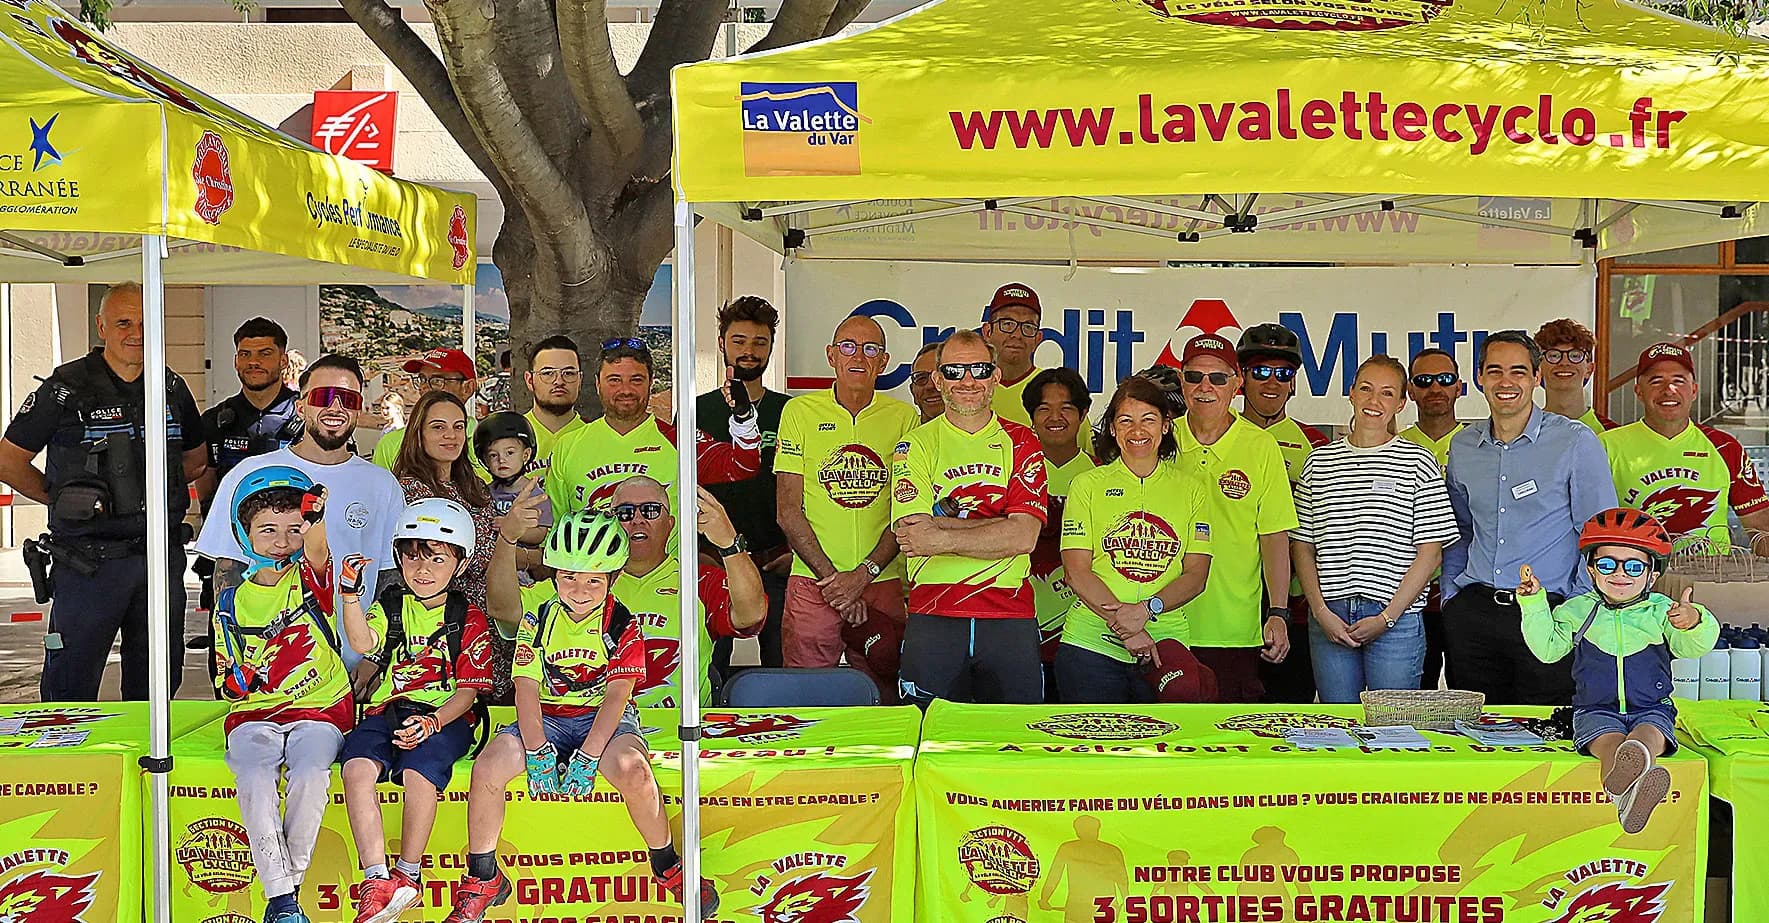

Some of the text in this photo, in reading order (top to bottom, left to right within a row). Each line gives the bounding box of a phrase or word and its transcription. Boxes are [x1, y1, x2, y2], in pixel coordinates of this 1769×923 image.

[743, 109, 856, 130] La Valette
[949, 87, 1688, 155] www.lavalettecyclo.fr
[807, 132, 855, 145] du Var
[306, 191, 343, 228] Cycles
[90, 407, 122, 417] POLICE
[586, 462, 649, 481] VALETTE
[837, 470, 888, 481] VALETTE
[943, 463, 1003, 481] VALETTE
[1640, 467, 1701, 486] VALETTE
[840, 480, 872, 489] CYCLO
[1624, 488, 1640, 504] LA
[1103, 537, 1180, 554] LA VALETTE
[1125, 549, 1160, 560] CYCLO
[546, 648, 598, 663] VALETTE
[15, 783, 86, 796] CAPABLE
[90, 782, 99, 795] ?
[699, 796, 729, 807] PAS
[732, 796, 752, 807] EN
[755, 795, 795, 807] ETRE
[797, 794, 868, 806] CAPABLE
[870, 792, 880, 804] ?
[945, 791, 988, 806] VOUS
[992, 799, 1066, 812] AIMERIEZ
[1069, 798, 1114, 812] FAIRE
[1117, 798, 1139, 811] DU
[1141, 794, 1182, 811] VÉLO
[1187, 796, 1228, 810] DANS
[1233, 795, 1255, 808] UN
[1258, 794, 1298, 808] CLUB
[1302, 793, 1311, 806] ?
[1315, 792, 1358, 806] VOUS
[1361, 791, 1440, 805] CRAIGNEZ
[1443, 791, 1464, 804] DE
[1467, 791, 1490, 804] NE
[1492, 791, 1523, 805] PAS
[1527, 791, 1548, 805] EN
[1552, 791, 1592, 805] ETRE
[188, 819, 246, 834] SECTION VTT
[1006, 829, 1025, 843] VTT
[178, 848, 253, 863] LA VALETT
[500, 853, 564, 867] VOUS
[568, 850, 651, 867] PROPO
[960, 846, 979, 862] LA
[203, 859, 240, 872] CYCLO
[1134, 864, 1461, 882] NOTRE CLUB VOUS PROPOSE
[751, 852, 847, 897] LA VALETTE
[317, 884, 340, 910] 3
[516, 874, 684, 905] GRATUIT
[1541, 858, 1648, 910] LA VALETTE
[1093, 895, 1504, 923] 3 SORTIES GRATUITES
